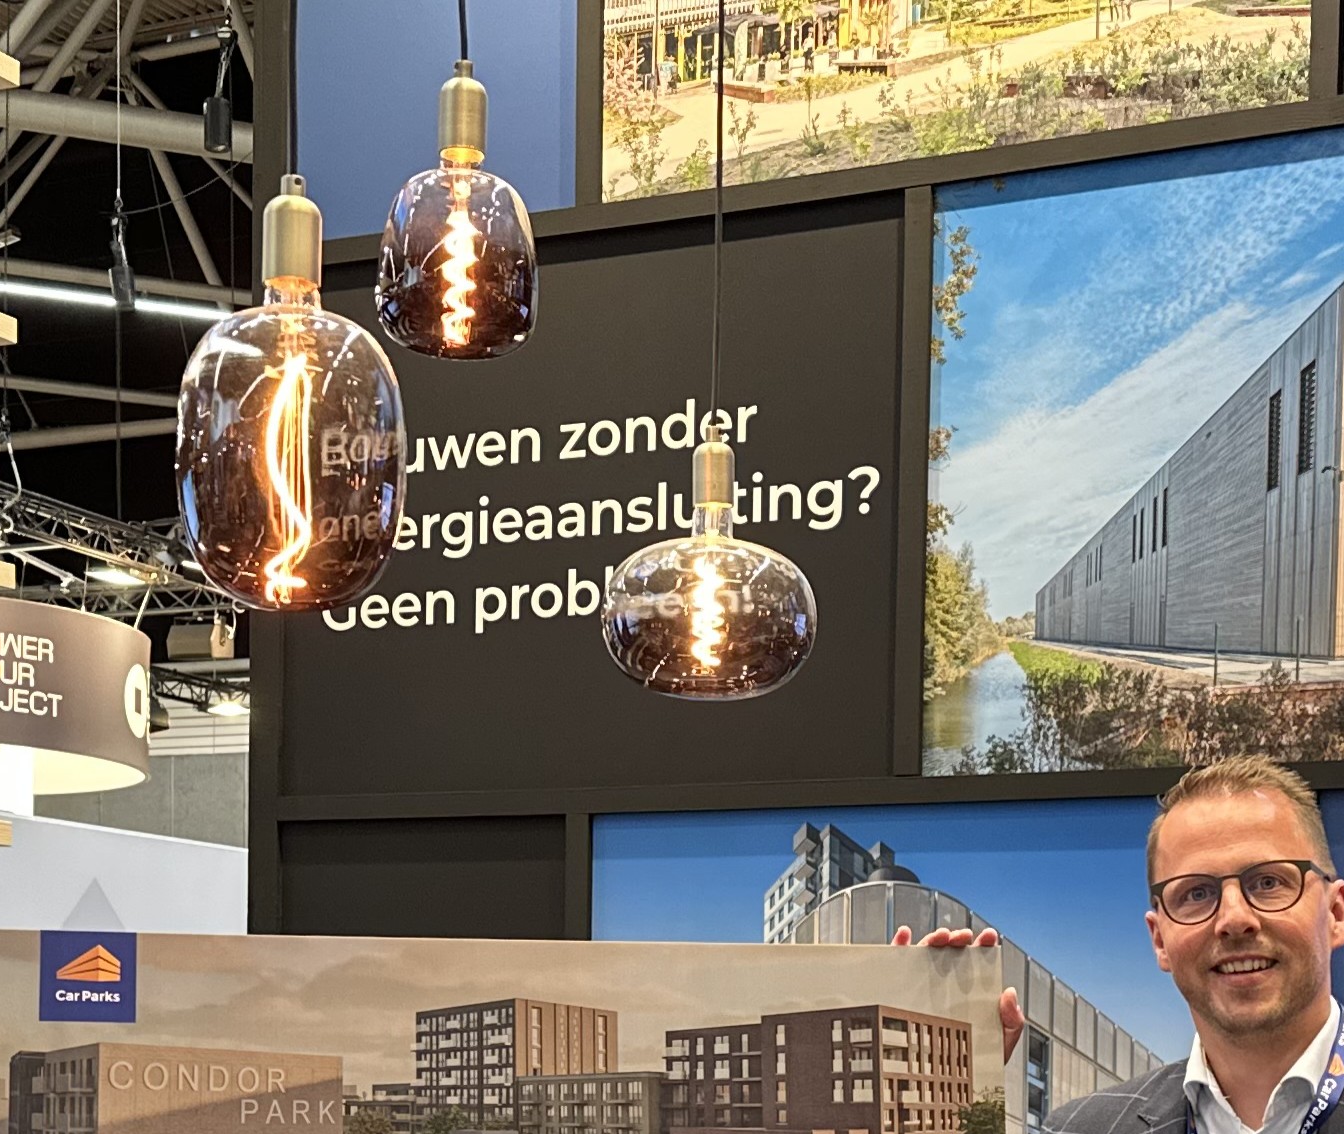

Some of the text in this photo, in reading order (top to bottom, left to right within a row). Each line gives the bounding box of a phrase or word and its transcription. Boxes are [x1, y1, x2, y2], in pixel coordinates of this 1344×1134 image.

[559, 398, 758, 460] zonder
[55, 989, 121, 1003] Car Parks
[108, 1059, 286, 1094] CONDOR
[1320, 1078, 1338, 1101] Car
[240, 1098, 336, 1125] PARK
